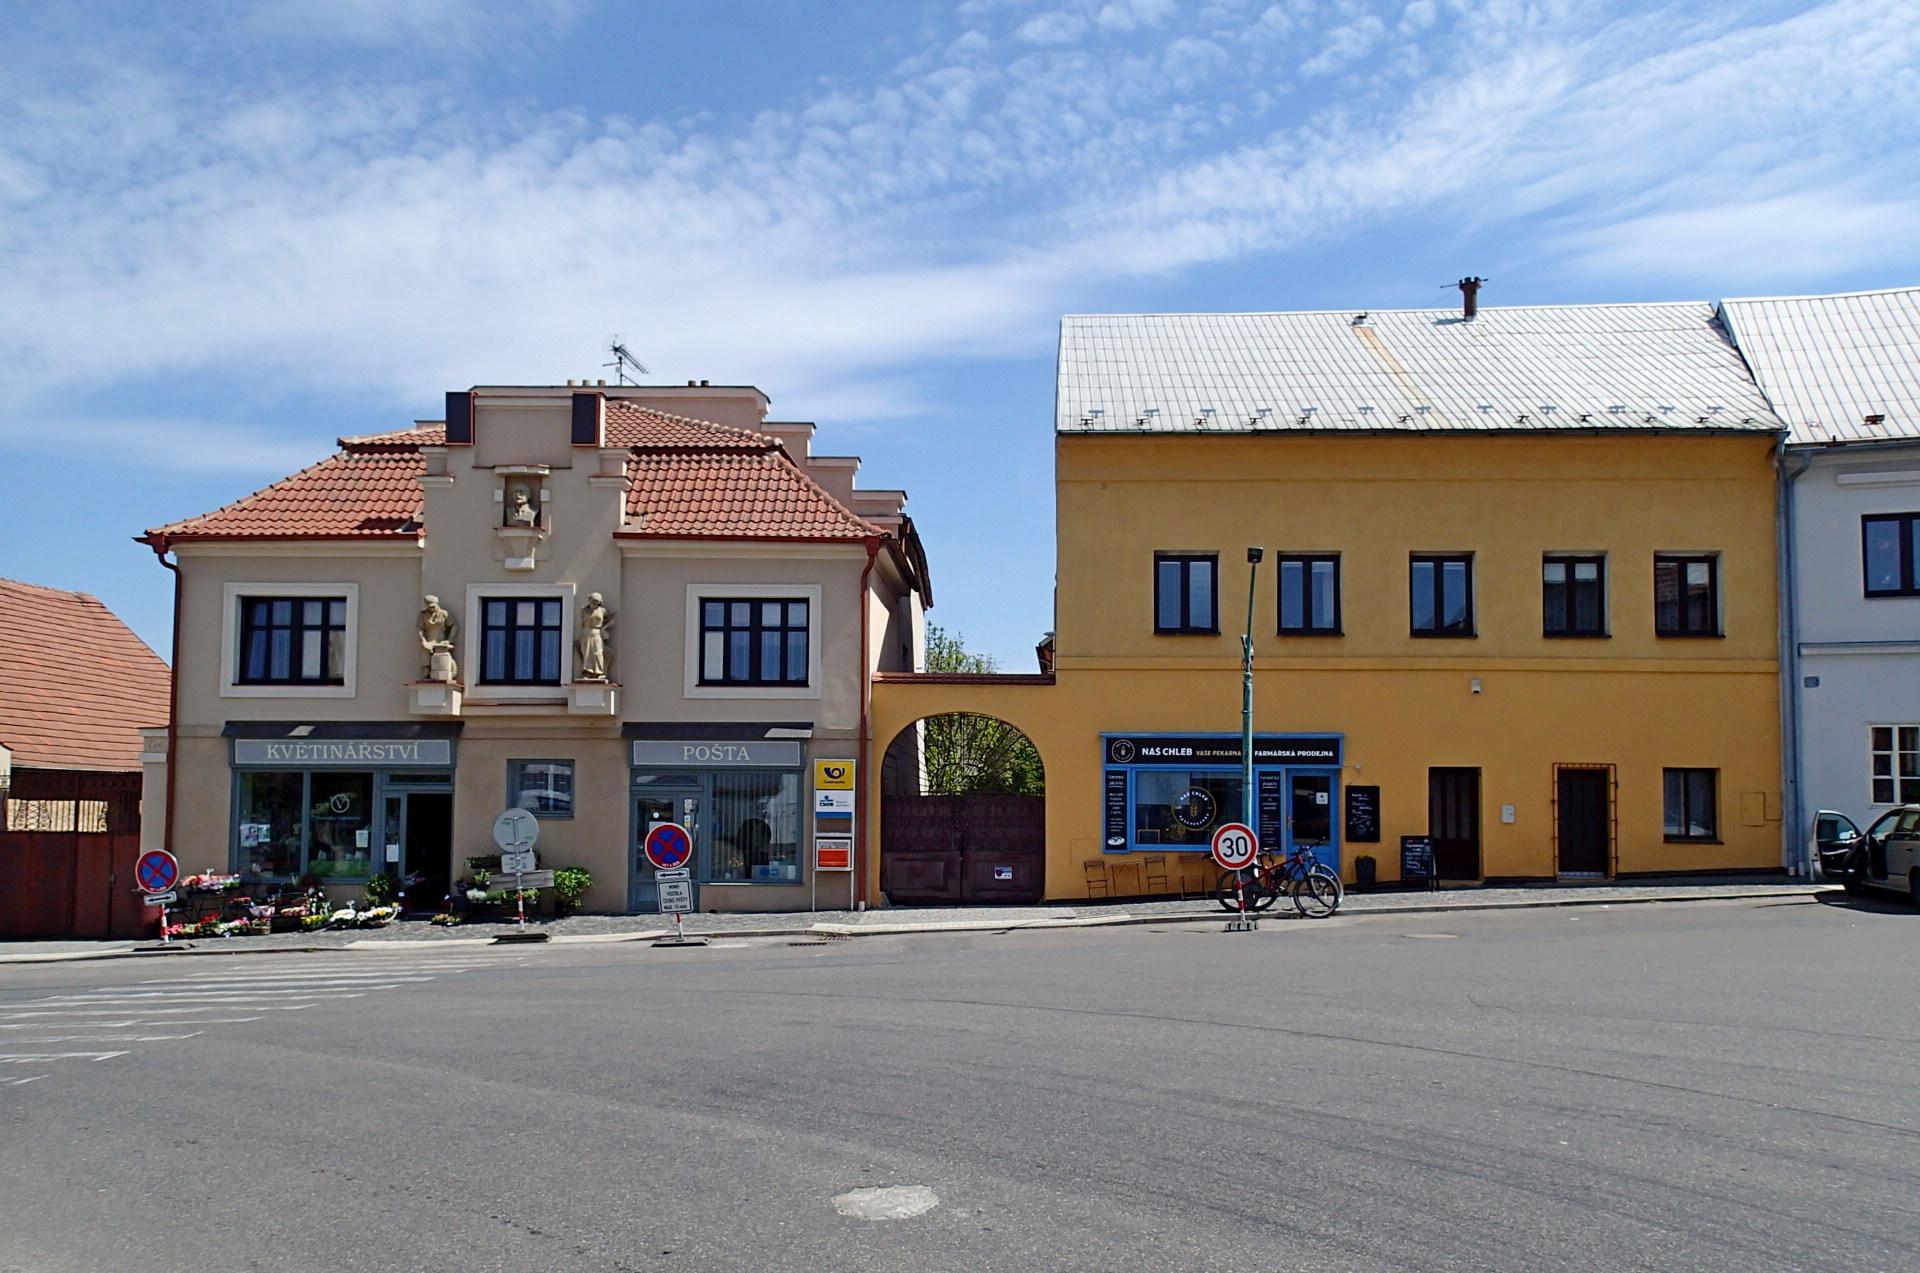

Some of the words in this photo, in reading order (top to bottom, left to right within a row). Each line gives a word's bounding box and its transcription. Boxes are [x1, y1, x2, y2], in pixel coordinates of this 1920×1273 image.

[267, 742, 419, 760] KVĚTINÁŘSTVÍ
[683, 744, 750, 761] POŠTA
[1222, 836, 1248, 858] 30
